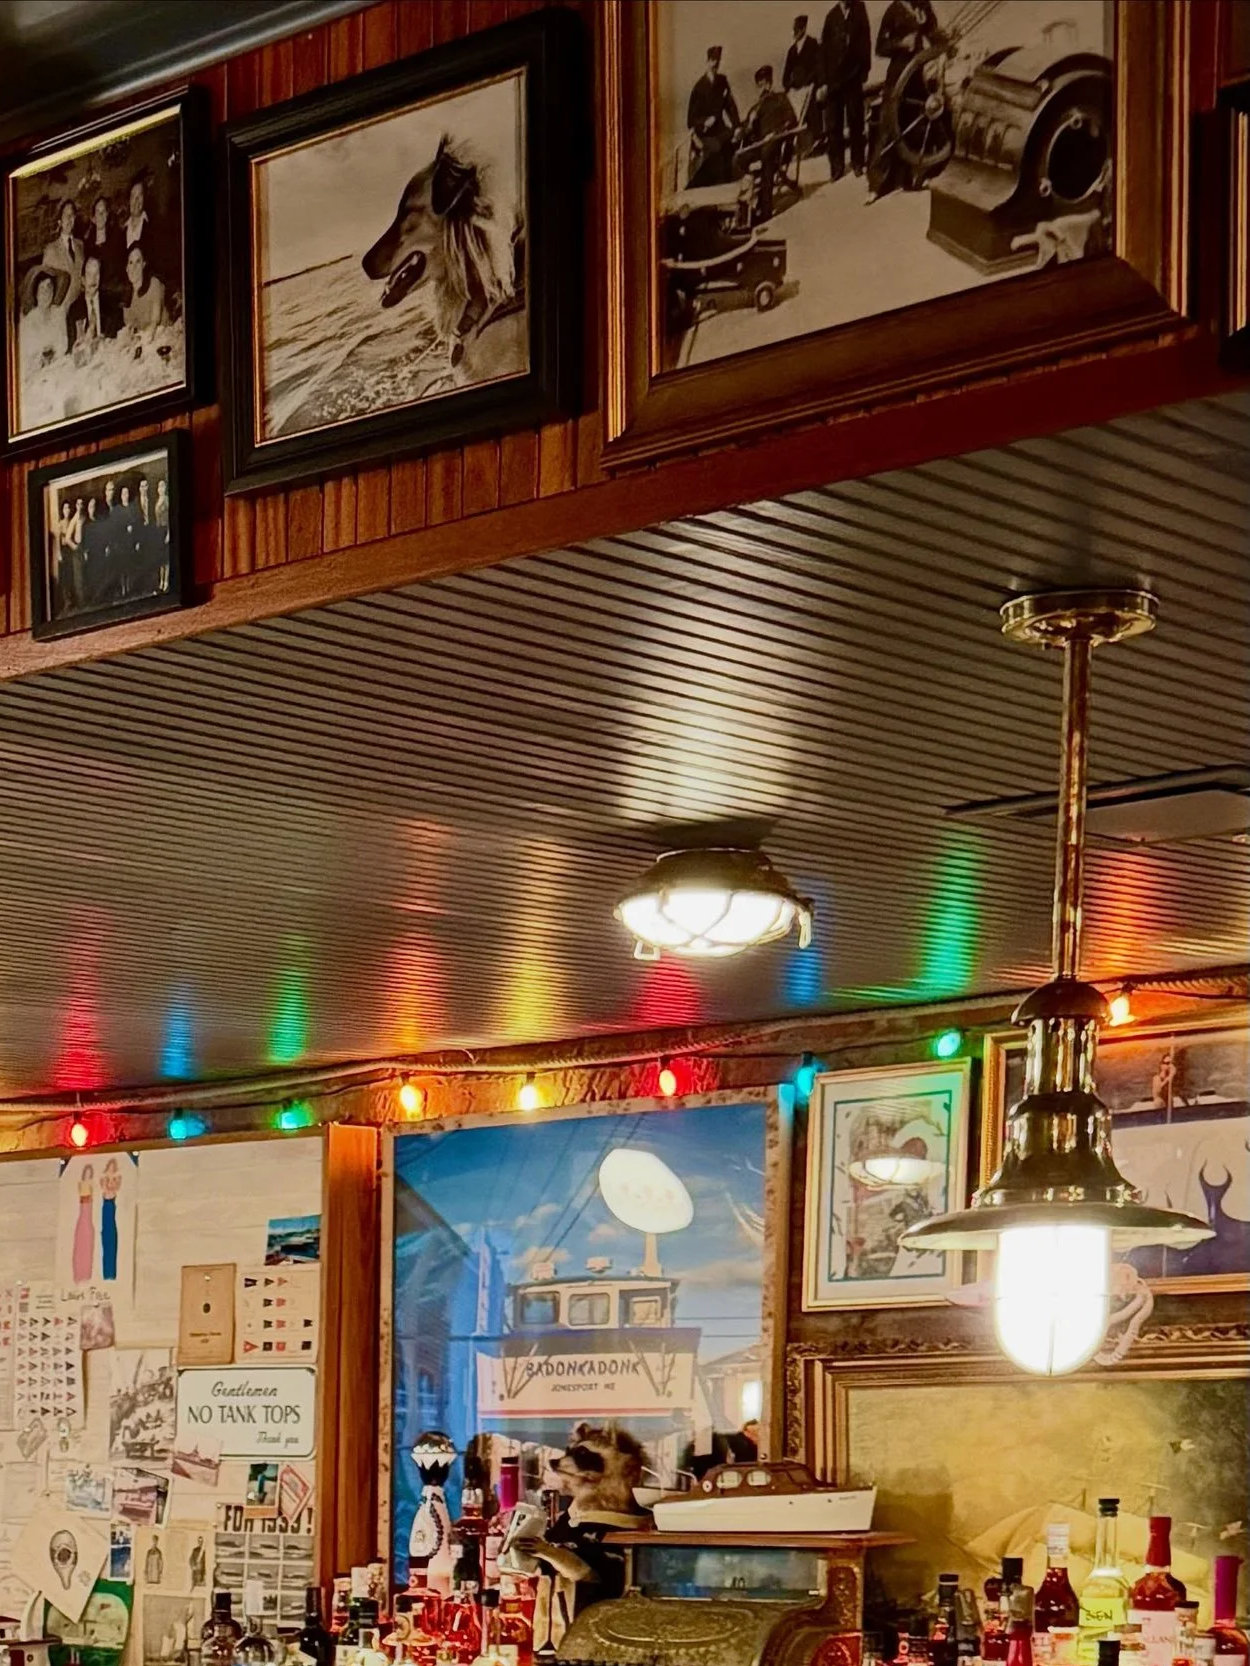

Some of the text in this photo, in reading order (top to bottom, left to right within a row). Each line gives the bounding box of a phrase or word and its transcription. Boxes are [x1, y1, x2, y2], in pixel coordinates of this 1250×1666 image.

[526, 1359, 640, 1377] BADONKADONK
[211, 1381, 278, 1397] Gentlemen
[188, 1404, 301, 1424] NO TANK TOPS
[255, 1431, 300, 1449] Thank you
